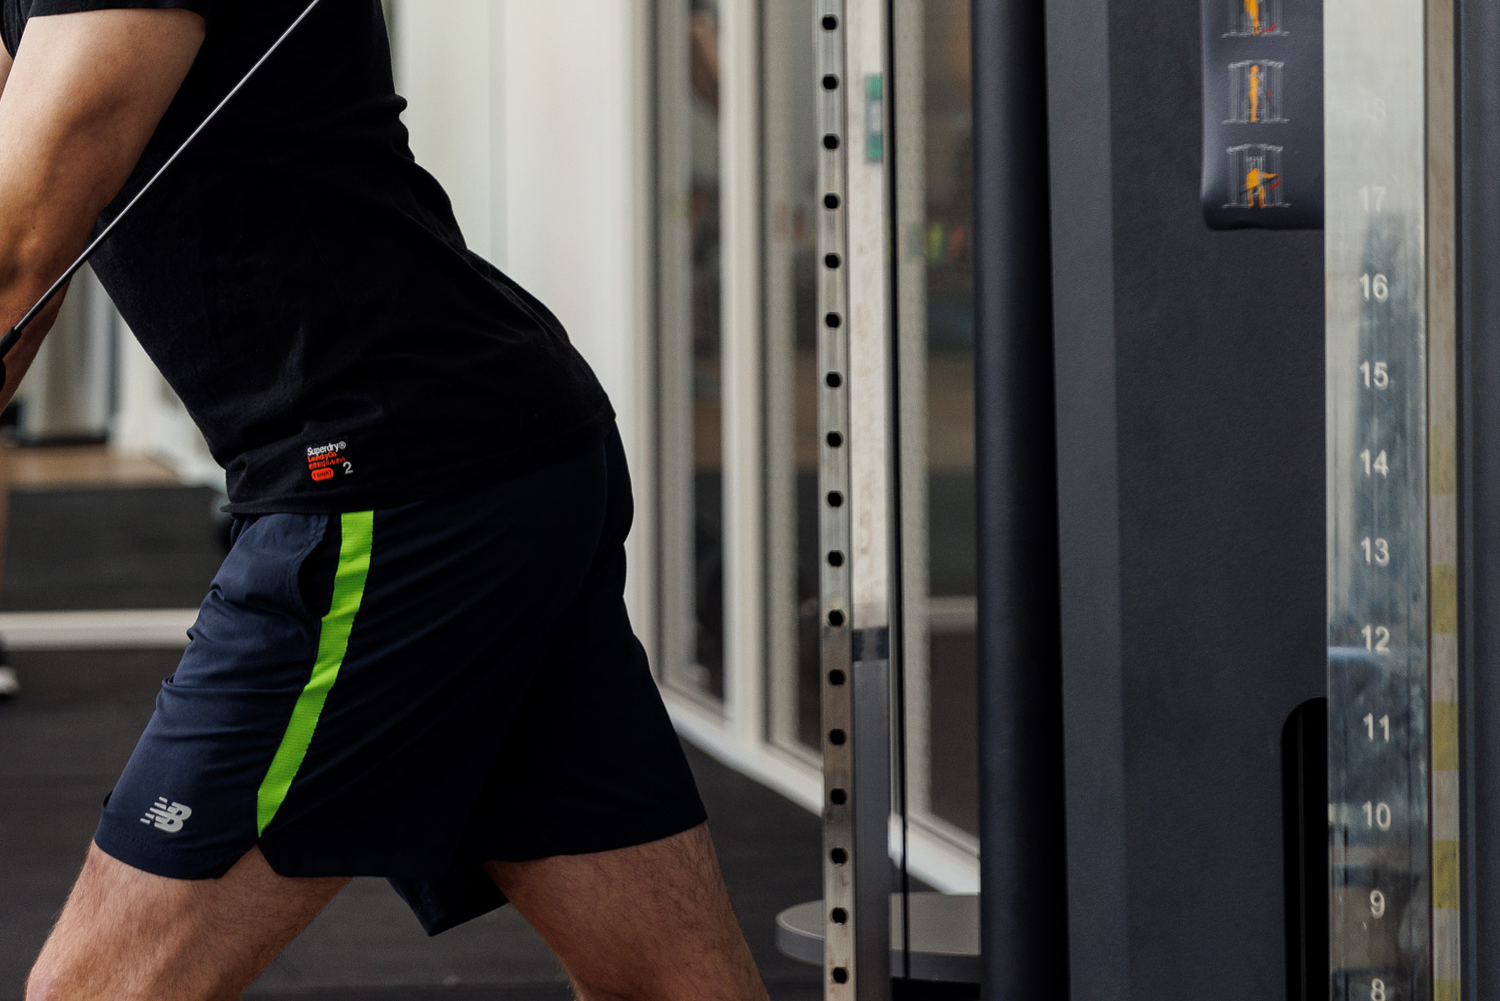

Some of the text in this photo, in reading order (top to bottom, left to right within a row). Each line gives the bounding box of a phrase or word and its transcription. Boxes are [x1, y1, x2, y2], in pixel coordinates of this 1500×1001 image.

[1359, 185, 1387, 213] 17
[1359, 273, 1389, 303] 16
[1359, 361, 1390, 390] 15
[342, 460, 354, 475] 2
[1360, 449, 1390, 478] 14
[1361, 537, 1390, 567] 13
[1361, 624, 1391, 655] 12
[1363, 712, 1390, 742] 11
[1362, 801, 1392, 831] 10
[1369, 889, 1386, 919] 9
[1370, 978, 1386, 1001] 8
